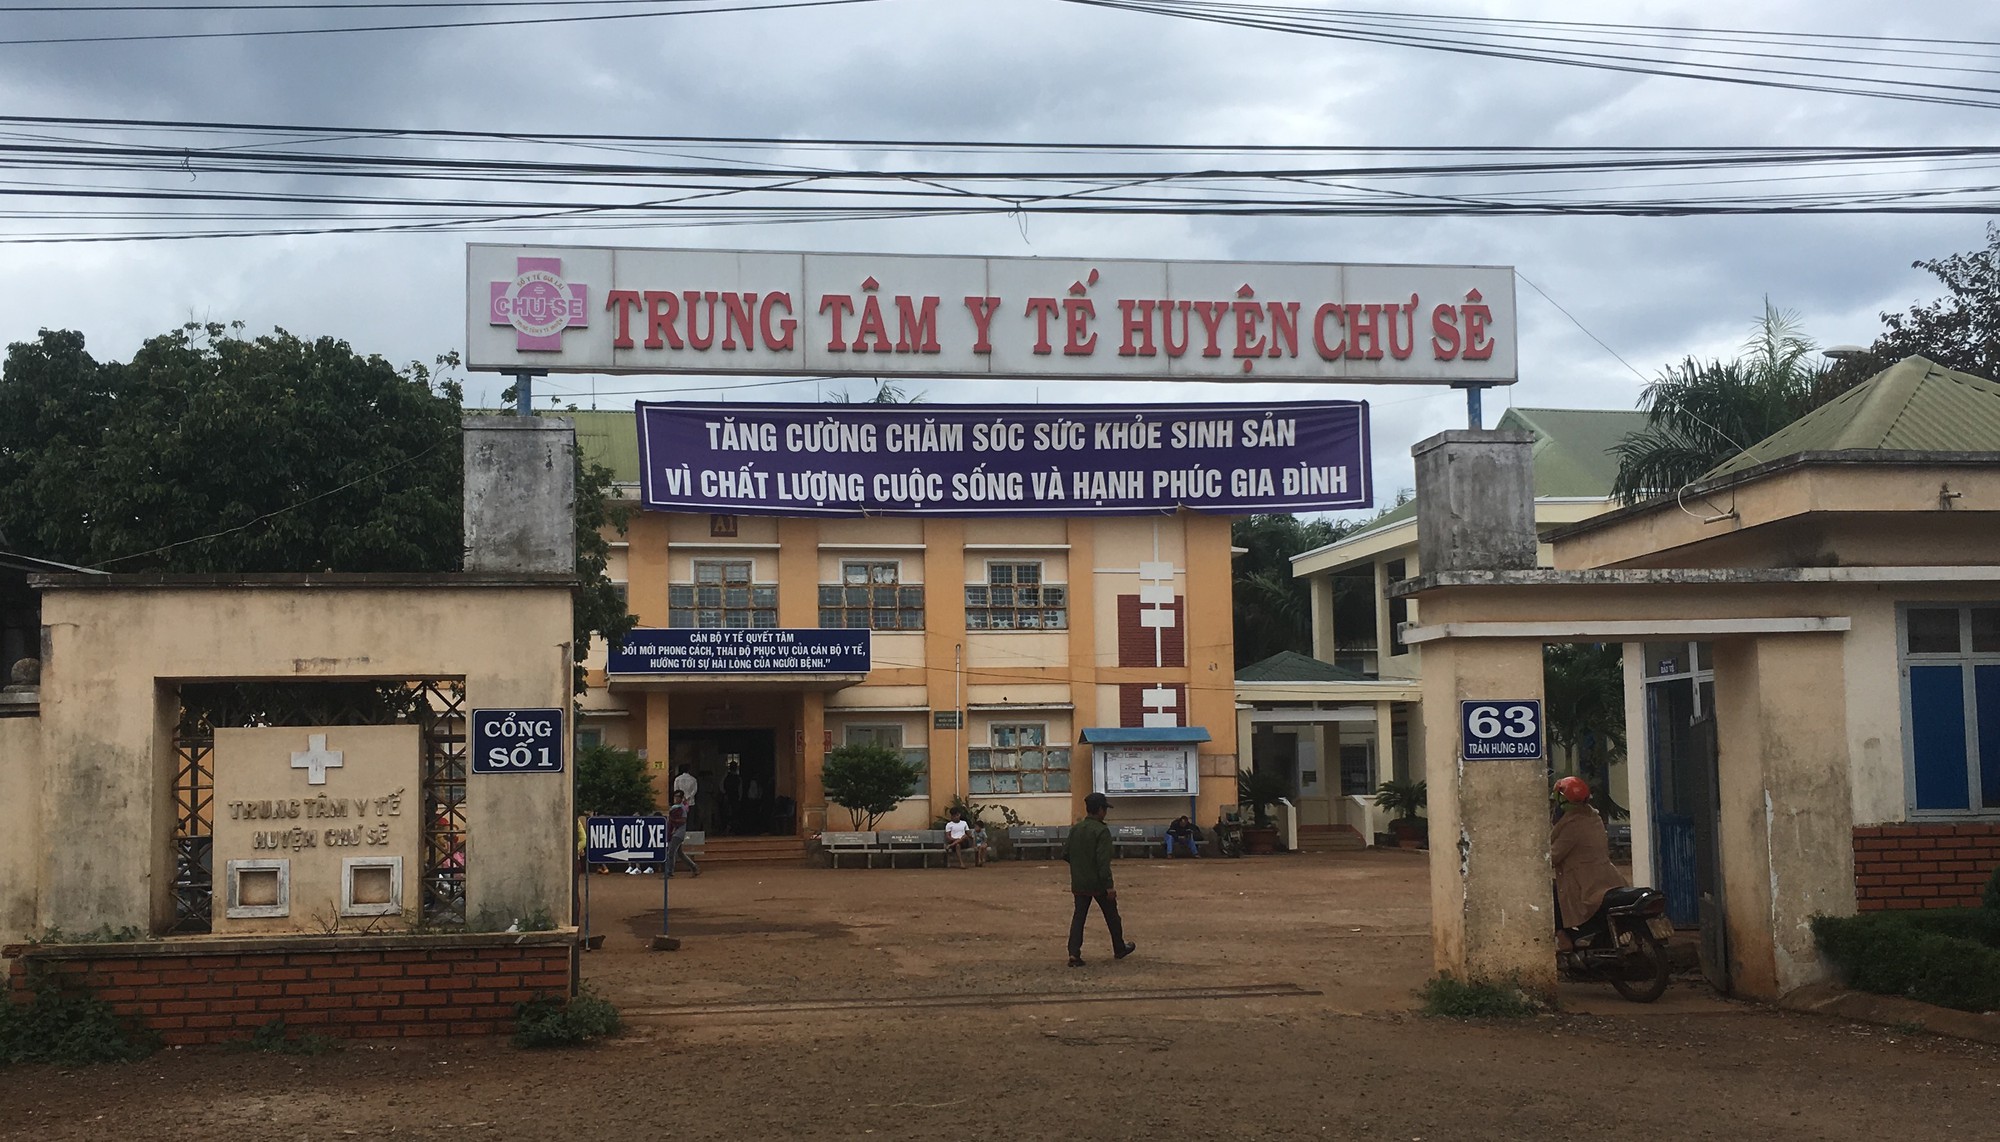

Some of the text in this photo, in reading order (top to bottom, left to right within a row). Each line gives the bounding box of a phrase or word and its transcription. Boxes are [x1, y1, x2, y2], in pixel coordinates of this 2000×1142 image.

[605, 268, 1495, 373] TRUNG TÂM Y TẾ HUYỆN CHƯ SÊ
[705, 411, 1296, 453] TĂNG CƯỜNG CHĂM SÓC SỨC KHỎE SINH SẢN
[665, 461, 1348, 508] VÌ CHẤT LƯỢNG CUỘC SỐNG VÀ HẠNH PHÚC GIA ĐÌNH
[713, 515, 736, 532] A1
[639, 642, 656, 656] MỚI
[658, 645, 687, 656] PHONG
[689, 643, 715, 657] CÁCH,
[716, 643, 737, 656] THÁI
[738, 643, 751, 657] ĐỘ
[753, 645, 776, 657] PHỤC
[778, 645, 789, 657] VỤ
[791, 642, 809, 656] CỦA
[810, 643, 828, 655] CÁN
[830, 643, 842, 657] BỘ
[844, 645, 850, 655] Y
[851, 642, 866, 657] TẾ,
[690, 630, 794, 644] CÁN BỘ Y TẾ QUYẾT TÂM
[650, 656, 680, 668] HƯỚNG
[681, 656, 696, 668] TỚI
[698, 657, 711, 670] SỰ
[712, 657, 727, 668] HÀI
[728, 657, 752, 669] LÒNG
[753, 655, 771, 669] CỦA
[773, 656, 799, 668] NGƯỜI
[484, 711, 552, 737] CỔNG
[1468, 706, 1536, 739] 63
[488, 738, 553, 767] SỐ 1
[1491, 741, 1516, 754] HƯNG
[1517, 742, 1536, 755] ĐẠO
[228, 787, 405, 820] TRUNG TÂM Y TẾ
[252, 821, 390, 852] HUYỆN CHƯ SÊ
[590, 818, 665, 849] NHÀ GIỮ XE
